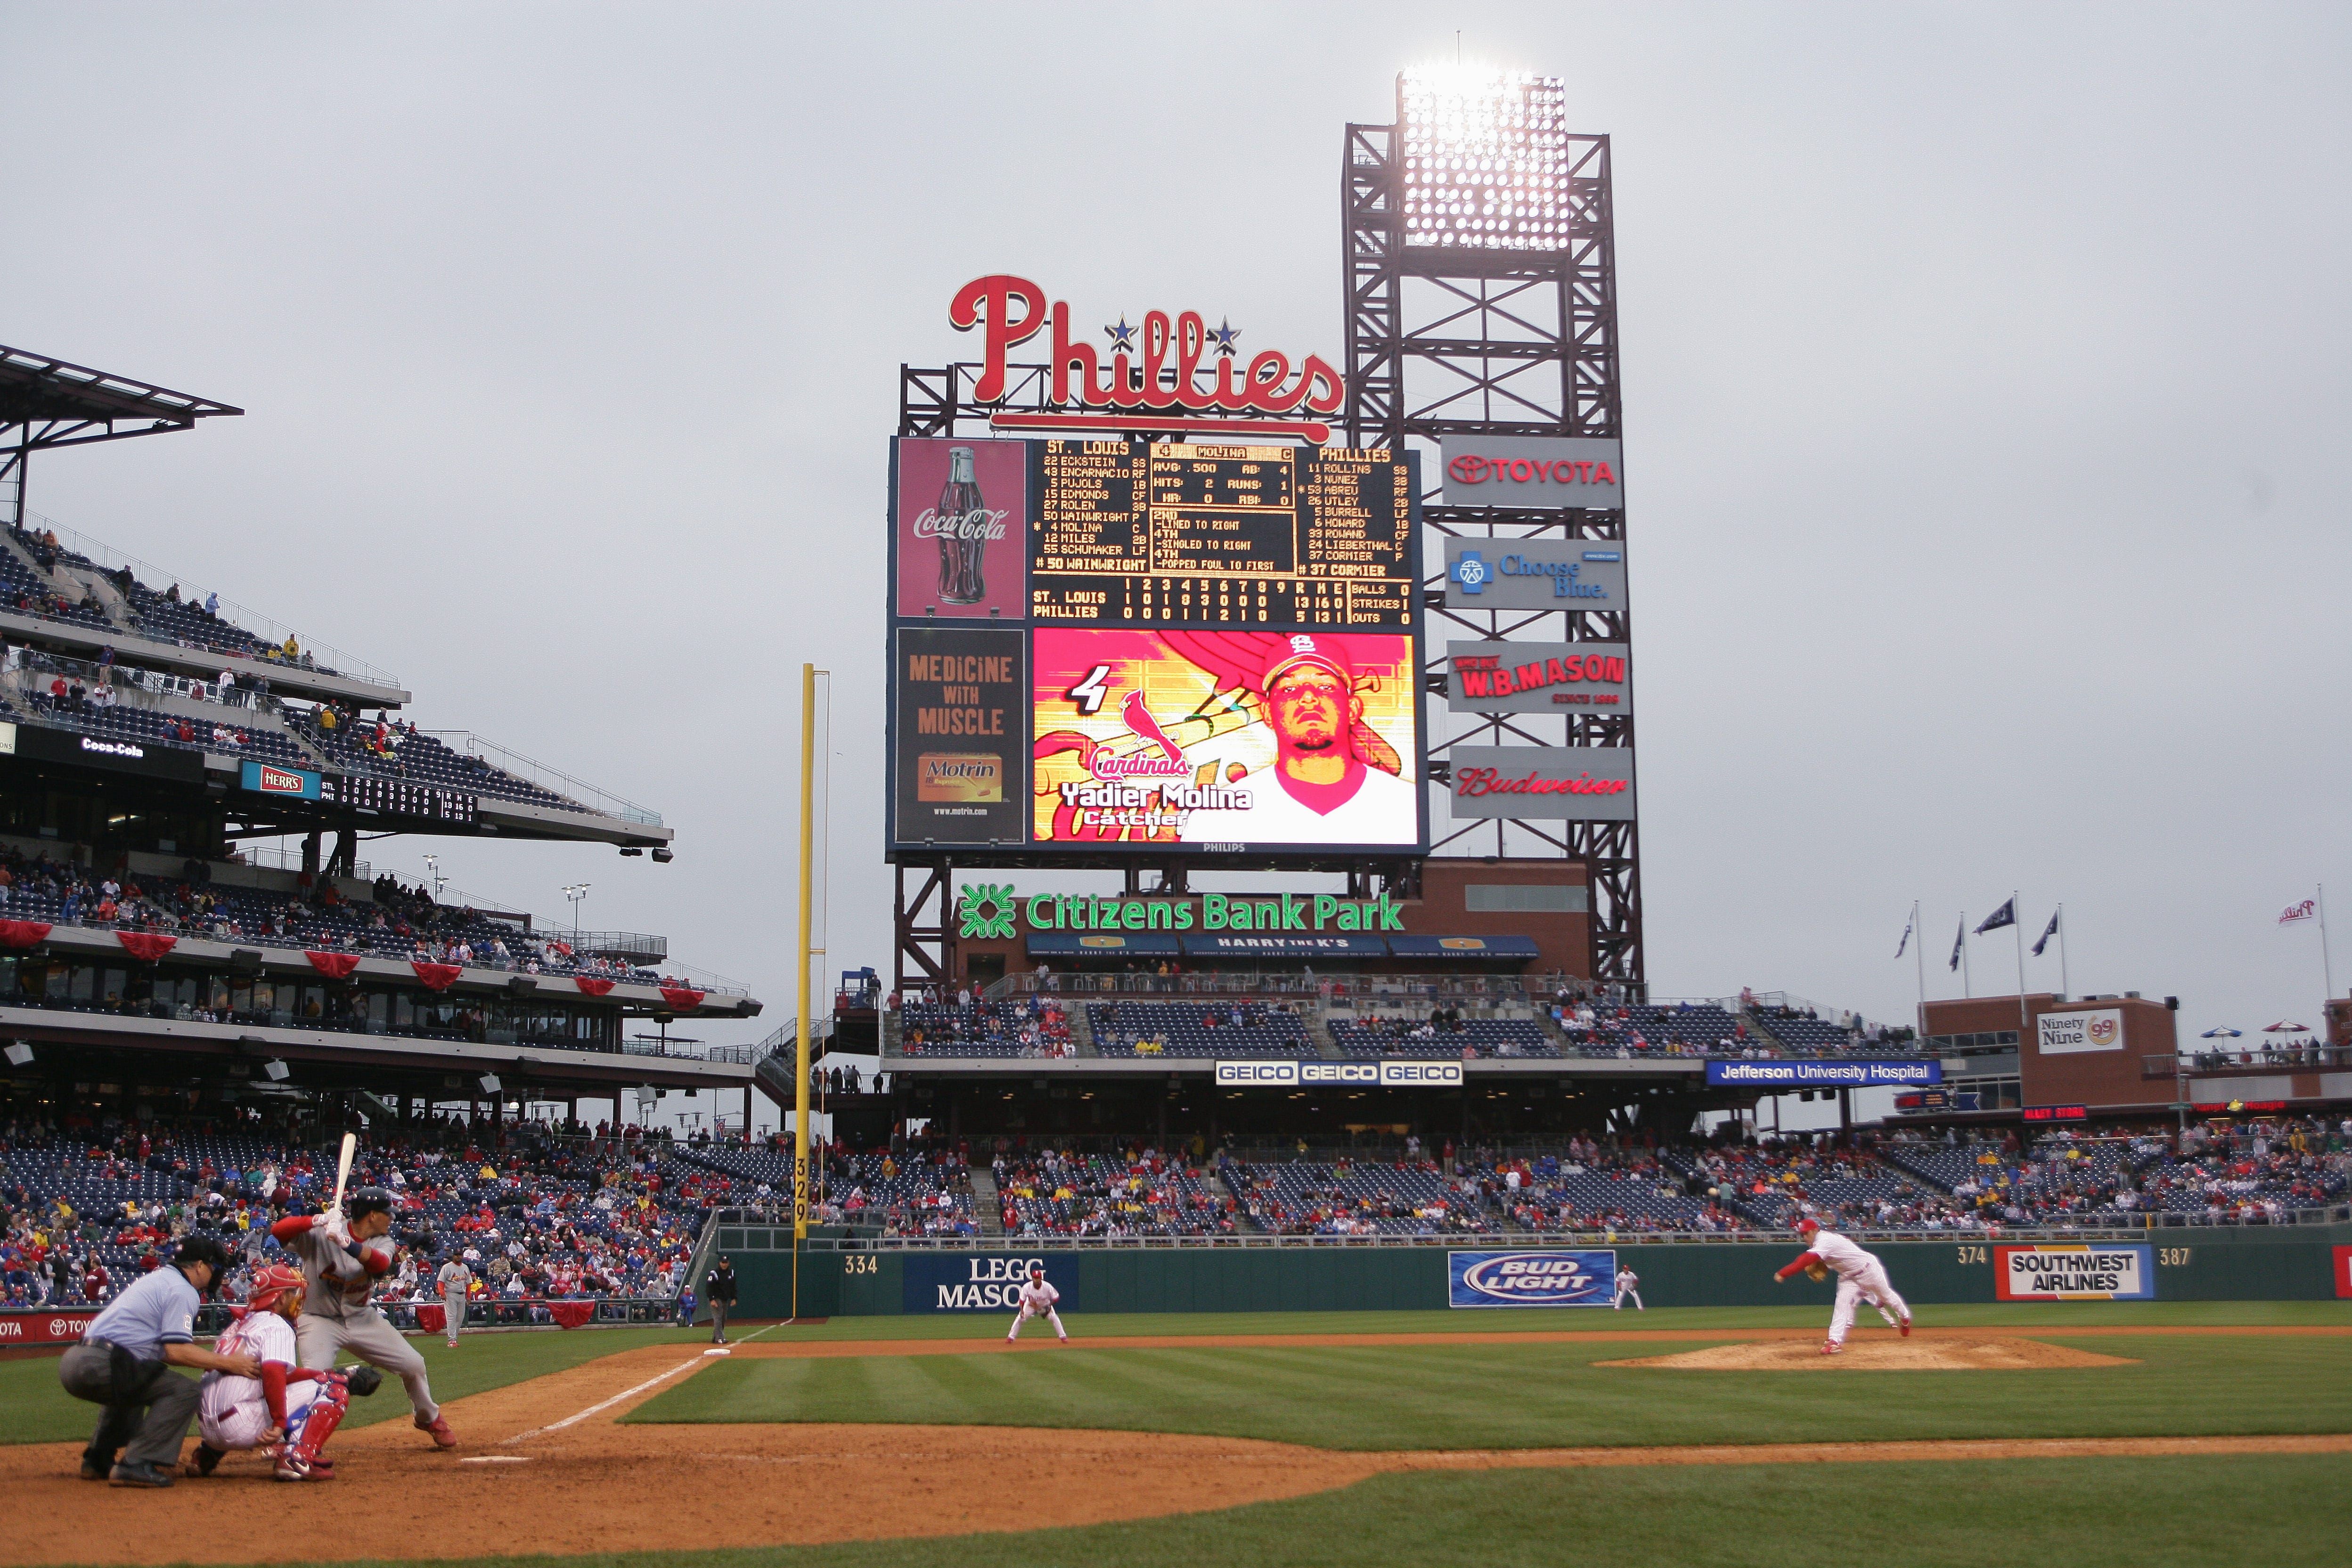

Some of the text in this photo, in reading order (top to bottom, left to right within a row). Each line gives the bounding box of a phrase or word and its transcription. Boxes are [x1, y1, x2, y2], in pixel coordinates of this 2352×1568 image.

[948, 274, 1345, 417] Phillies
[1047, 440, 1129, 455] ST. LOUIS
[1160, 445, 1291, 459] 4 MOLINA C
[1044, 456, 1116, 467] 22 ECKSTEIN
[1319, 448, 1391, 463] PHILLIES
[1061, 467, 1129, 478] ENCARNACIO
[1187, 463, 1217, 473] .500
[1280, 465, 1288, 475] 4
[1308, 463, 1372, 474] 11 ROLLINS
[1490, 458, 1616, 484] TOYOTA
[1051, 478, 1102, 489] 5 PUJOLS
[1205, 479, 1214, 488] 2
[1281, 481, 1287, 490] 1
[1314, 474, 1359, 485] 3 NUNEZ
[1045, 489, 1109, 499] 15 EDMONDS
[1324, 485, 1359, 495] ABREU
[1044, 500, 1095, 510] 27 ROLEN
[1204, 494, 1213, 503] 0
[1280, 496, 1289, 505] 0
[1307, 496, 1359, 506] 26 UTLEY
[1044, 511, 1129, 522] 50 WAINWRIGHT
[1154, 511, 1178, 520] 2ND
[1315, 507, 1372, 518] 5 BURRELL
[914, 508, 1009, 540] Coca-Cola
[1051, 522, 1102, 533] 4 MOLINA
[1195, 520, 1207, 530] TO
[1212, 521, 1240, 530] RIGHT
[1315, 518, 1366, 528] 6 HOWARD
[1045, 533, 1096, 543] 12 MILES
[1154, 529, 1178, 539] 4TH
[1325, 529, 1366, 539] ROWAND
[1044, 544, 1123, 555] 55 SCHUMAKER
[1207, 540, 1219, 550] TO
[1224, 540, 1251, 550] RIGHT
[1308, 539, 1393, 551] 24 LIEBERTHAL
[1154, 549, 1178, 558] 4TH
[1309, 550, 1373, 562] 37 CORMIER
[1047, 557, 1146, 571] 50 WAINWRIGHT
[1201, 560, 1225, 570] FOUL
[1230, 561, 1242, 570] TO
[1246, 561, 1274, 571] FIRST
[1500, 554, 1580, 576] Choose
[1310, 564, 1386, 577] 37 CORMIER
[1296, 582, 1343, 595] R H E
[1352, 584, 1410, 596] BALLS 0
[1554, 577, 1609, 598] Blue.
[1033, 591, 1343, 609] ST. LOUIS 13 16 0
[1352, 599, 1408, 610] STRIKES 1
[1033, 605, 1341, 623] PHILLIES 5 13 1
[1353, 613, 1410, 625] OUTS 0
[1071, 666, 1110, 710] 4
[1552, 694, 1590, 704] SINCE
[918, 708, 1004, 735] MUSCLE
[82, 738, 144, 758] Coca-Cola
[926, 760, 995, 777] Motrin
[1090, 745, 1192, 783] Cardinals
[265, 772, 299, 789] HERR'S
[322, 782, 335, 791] STL
[1457, 767, 1627, 797] Budweiser
[321, 792, 335, 800] PHI
[1061, 783, 1252, 809] Yadier Molina
[934, 807, 987, 815] www.motrin.com
[1084, 811, 1187, 826] Catcher
[1204, 843, 1245, 852] PHILIPS
[1026, 893, 1405, 930] Citizens Bank Park
[1218, 938, 1285, 947] HARRY
[1316, 939, 1349, 947] K'S
[2041, 1019, 2084, 1030] Ninety
[2091, 1020, 2113, 1037] 99
[2042, 1030, 2082, 1045] Nine
[1219, 1065, 1459, 1080] GEICO GEICO GEICO
[1721, 1065, 1928, 1081] Jefferson University Hospital
[2024, 1107, 2084, 1119] ALLEY STORE
[1957, 1246, 1987, 1264] 374
[2160, 1248, 2190, 1266] 387
[845, 1255, 877, 1274] 334
[1500, 1261, 1579, 1275] BUD
[2011, 1254, 2133, 1273] SOUTHWEST
[969, 1258, 1046, 1282] LEGG
[1485, 1275, 1593, 1290] LIGHT
[2031, 1273, 2119, 1291] AIRLINES
[937, 1284, 1022, 1309] MASO
[0, 1323, 23, 1335] OTA
[68, 1320, 94, 1332] TOY
